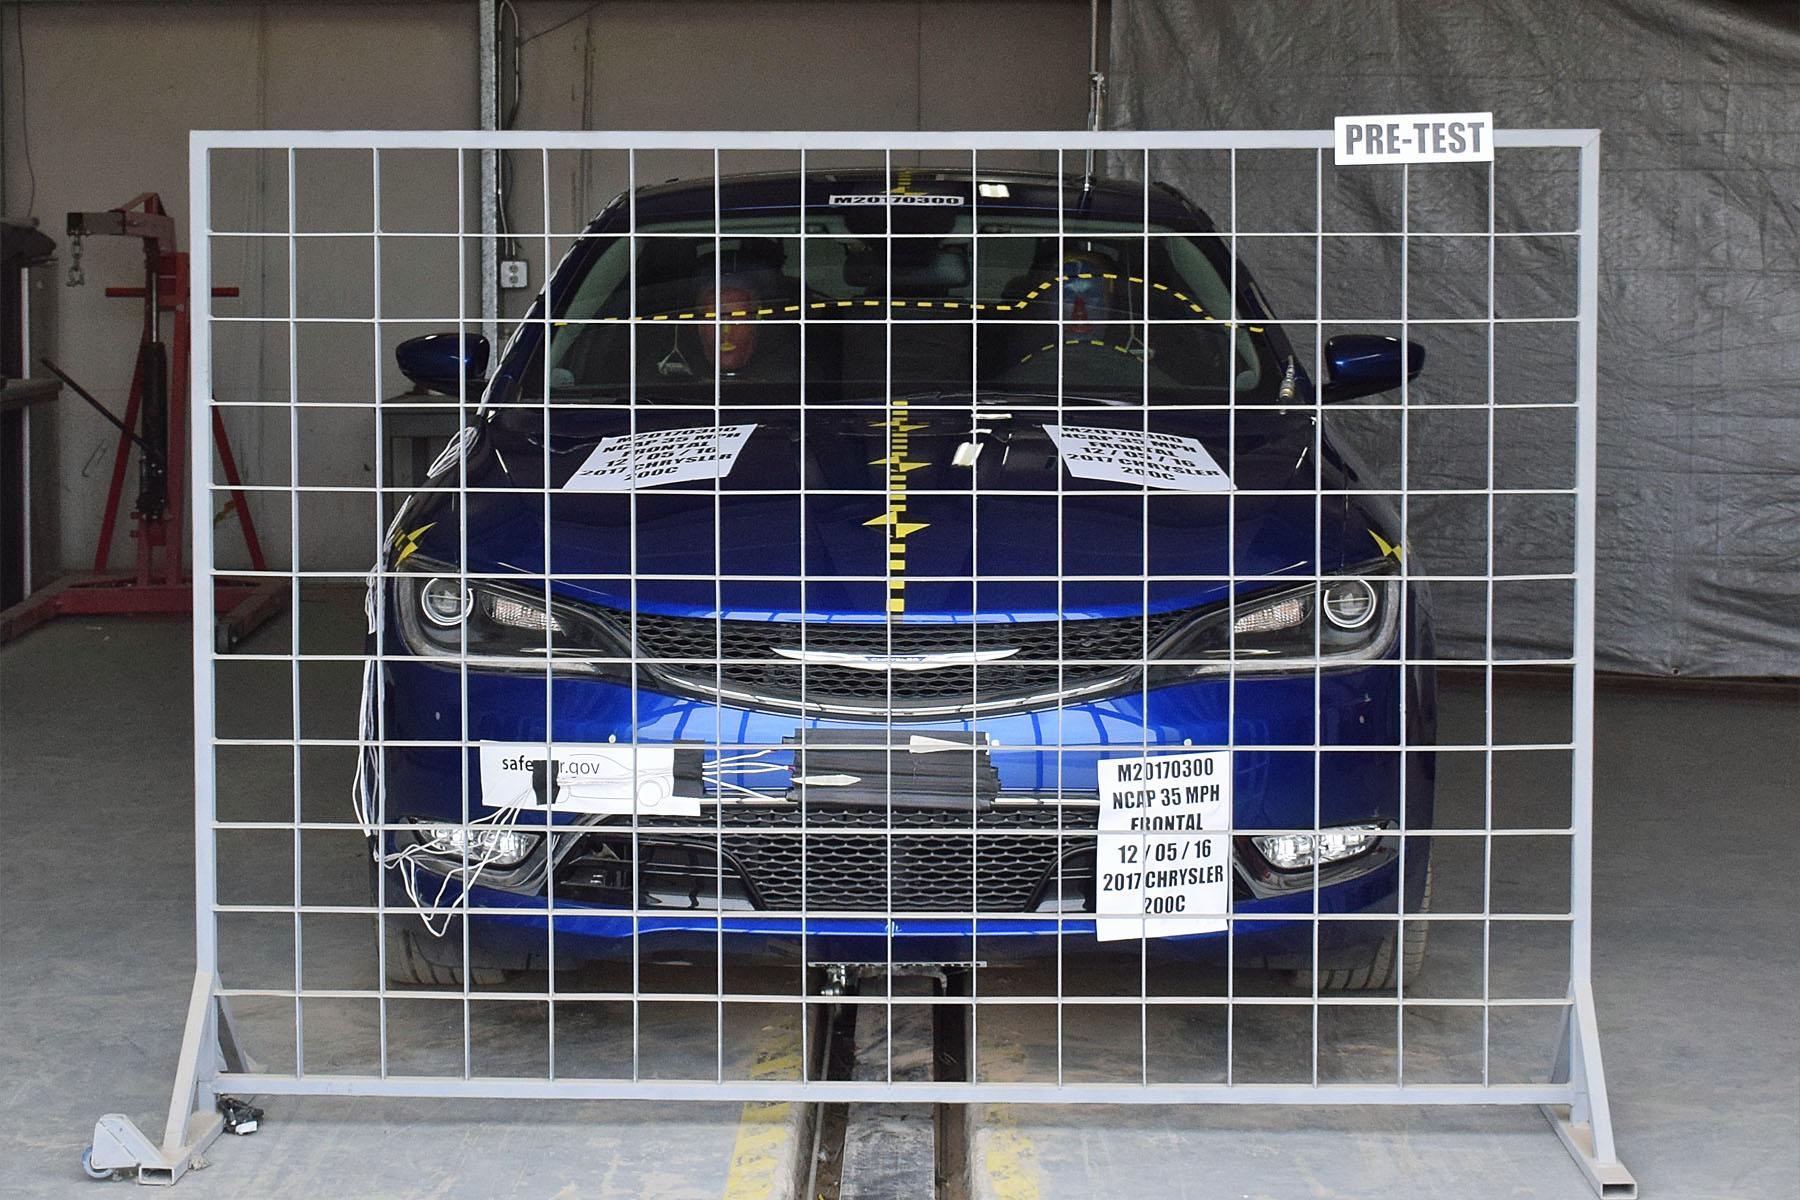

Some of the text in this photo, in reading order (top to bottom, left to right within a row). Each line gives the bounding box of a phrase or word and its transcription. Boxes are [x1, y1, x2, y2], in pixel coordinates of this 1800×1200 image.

[1345, 122, 1485, 155] PRE-TEST
[603, 439, 657, 453] NCAP
[661, 436, 688, 445] 35
[621, 441, 709, 457] FRONTAL
[1150, 440, 1198, 453] MPH
[579, 453, 733, 475] 2017 CHRYSLER
[606, 458, 628, 467] 12
[647, 451, 674, 461] 05
[1066, 453, 1221, 475] 2017 CHRYSLER
[1079, 447, 1105, 455] 12
[1124, 451, 1152, 460] 05
[1171, 457, 1196, 467] 16
[1121, 467, 1176, 481] 200C
[502, 755, 600, 778] safer.gov
[1118, 757, 1214, 782] M20170300
[1112, 784, 1220, 809] NCAP 35 MPH
[1130, 813, 1204, 831] FRONTAL
[1118, 839, 1212, 864] 12 / 05 / 16
[1103, 865, 1224, 891] 2017 CHRYSLER
[1144, 895, 1186, 914] 200C
